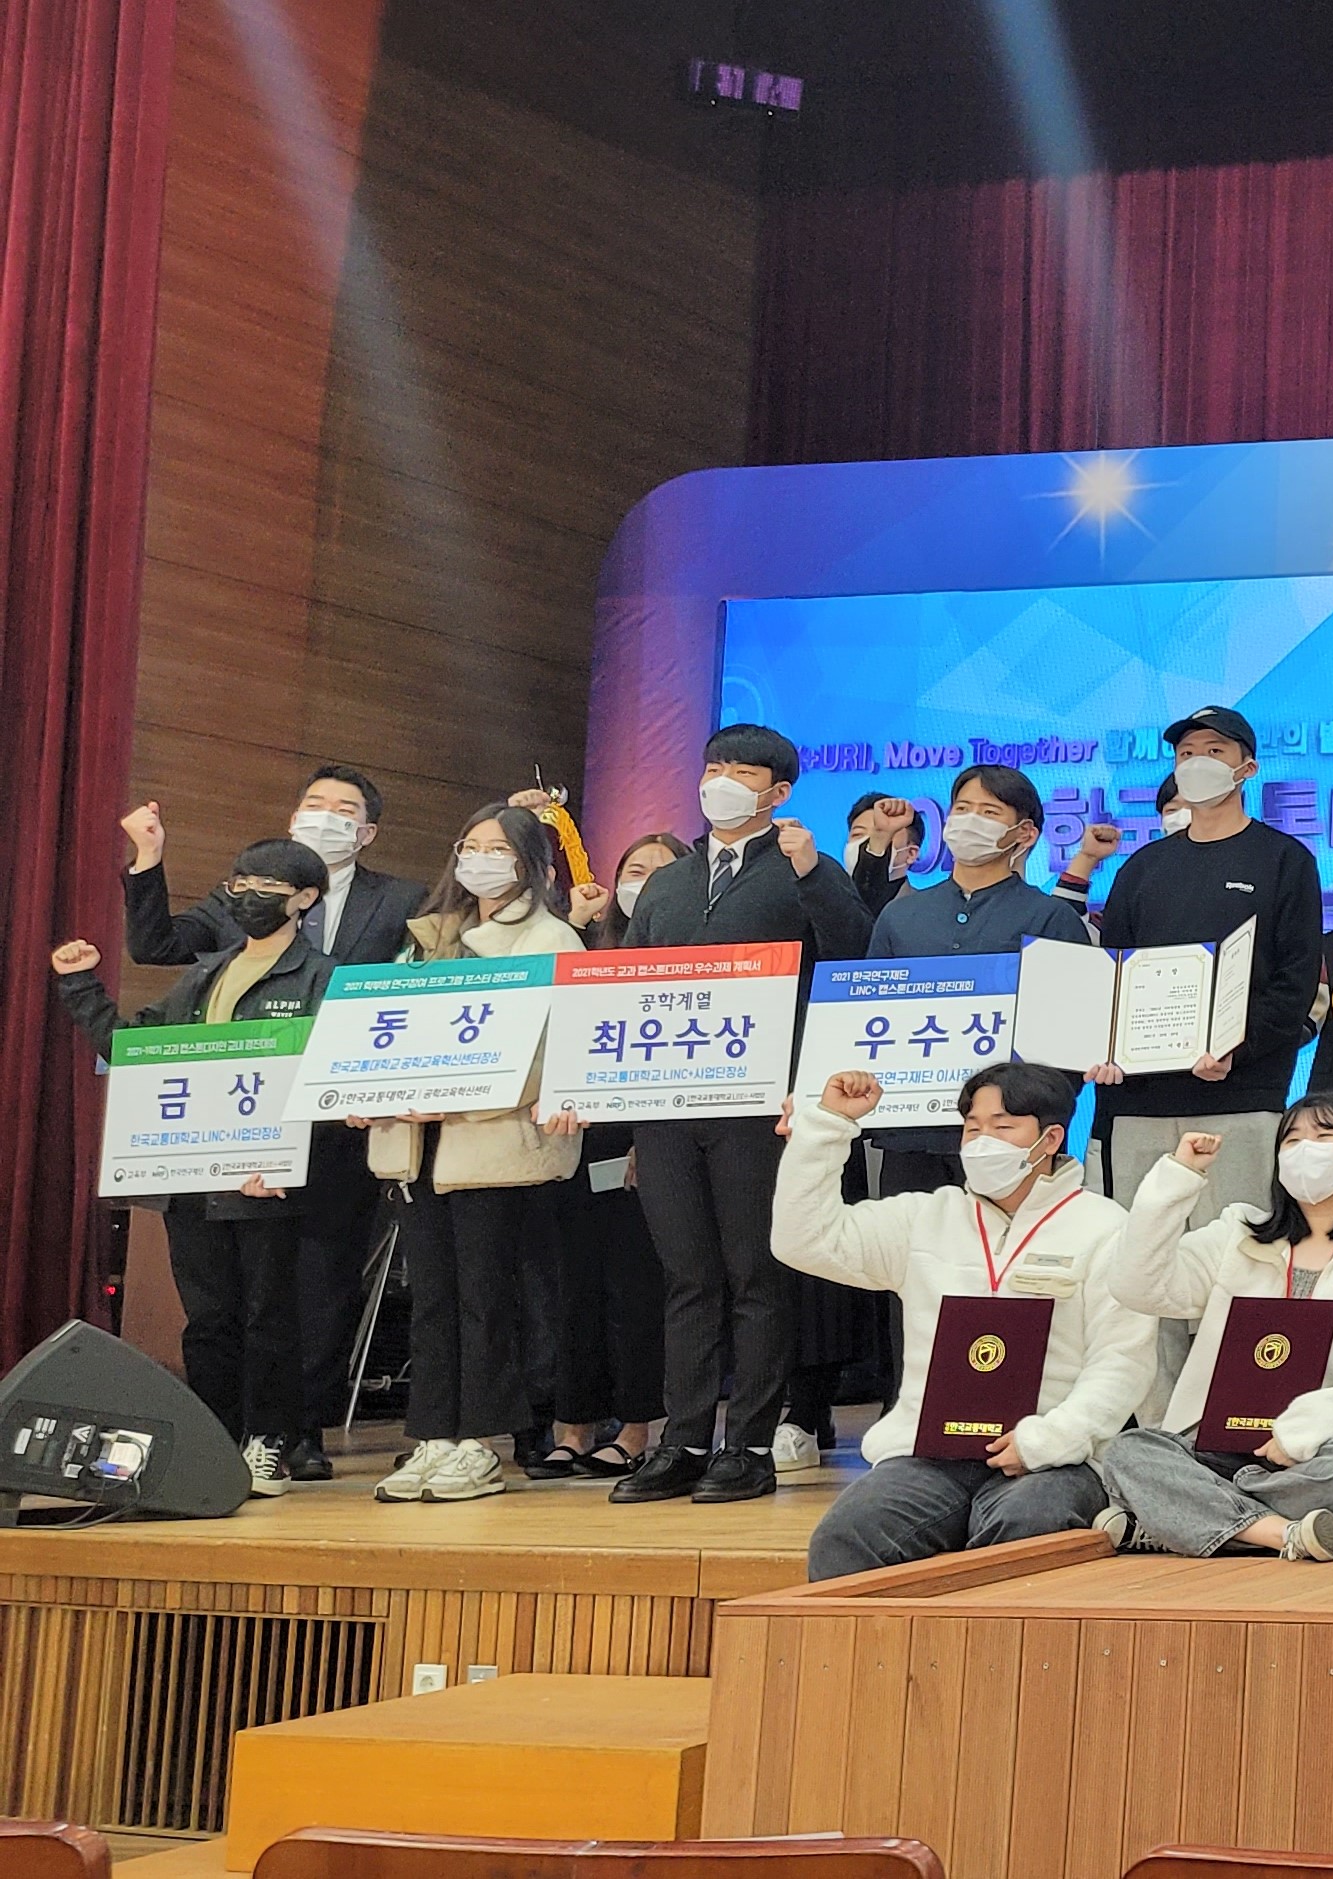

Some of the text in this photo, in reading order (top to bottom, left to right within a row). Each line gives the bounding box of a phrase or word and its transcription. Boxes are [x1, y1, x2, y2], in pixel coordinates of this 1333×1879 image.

[884, 742, 963, 769] Move
[970, 734, 1099, 768] Together
[572, 960, 761, 978] 2021학년도 교과 캡스톤디자인 우수과제 계획서
[832, 969, 909, 982] 2021 한국연구재단
[850, 980, 975, 996] LINC+ 캡스톤디자인 경진대회
[638, 991, 712, 1012] 공학계열
[588, 1015, 755, 1063] 최우수상
[330, 1058, 400, 1075] 한국교통대학교
[586, 1065, 747, 1085] 한국교통대학교 LINC+사업단장상
[130, 1131, 200, 1147] 한국교통대학교
